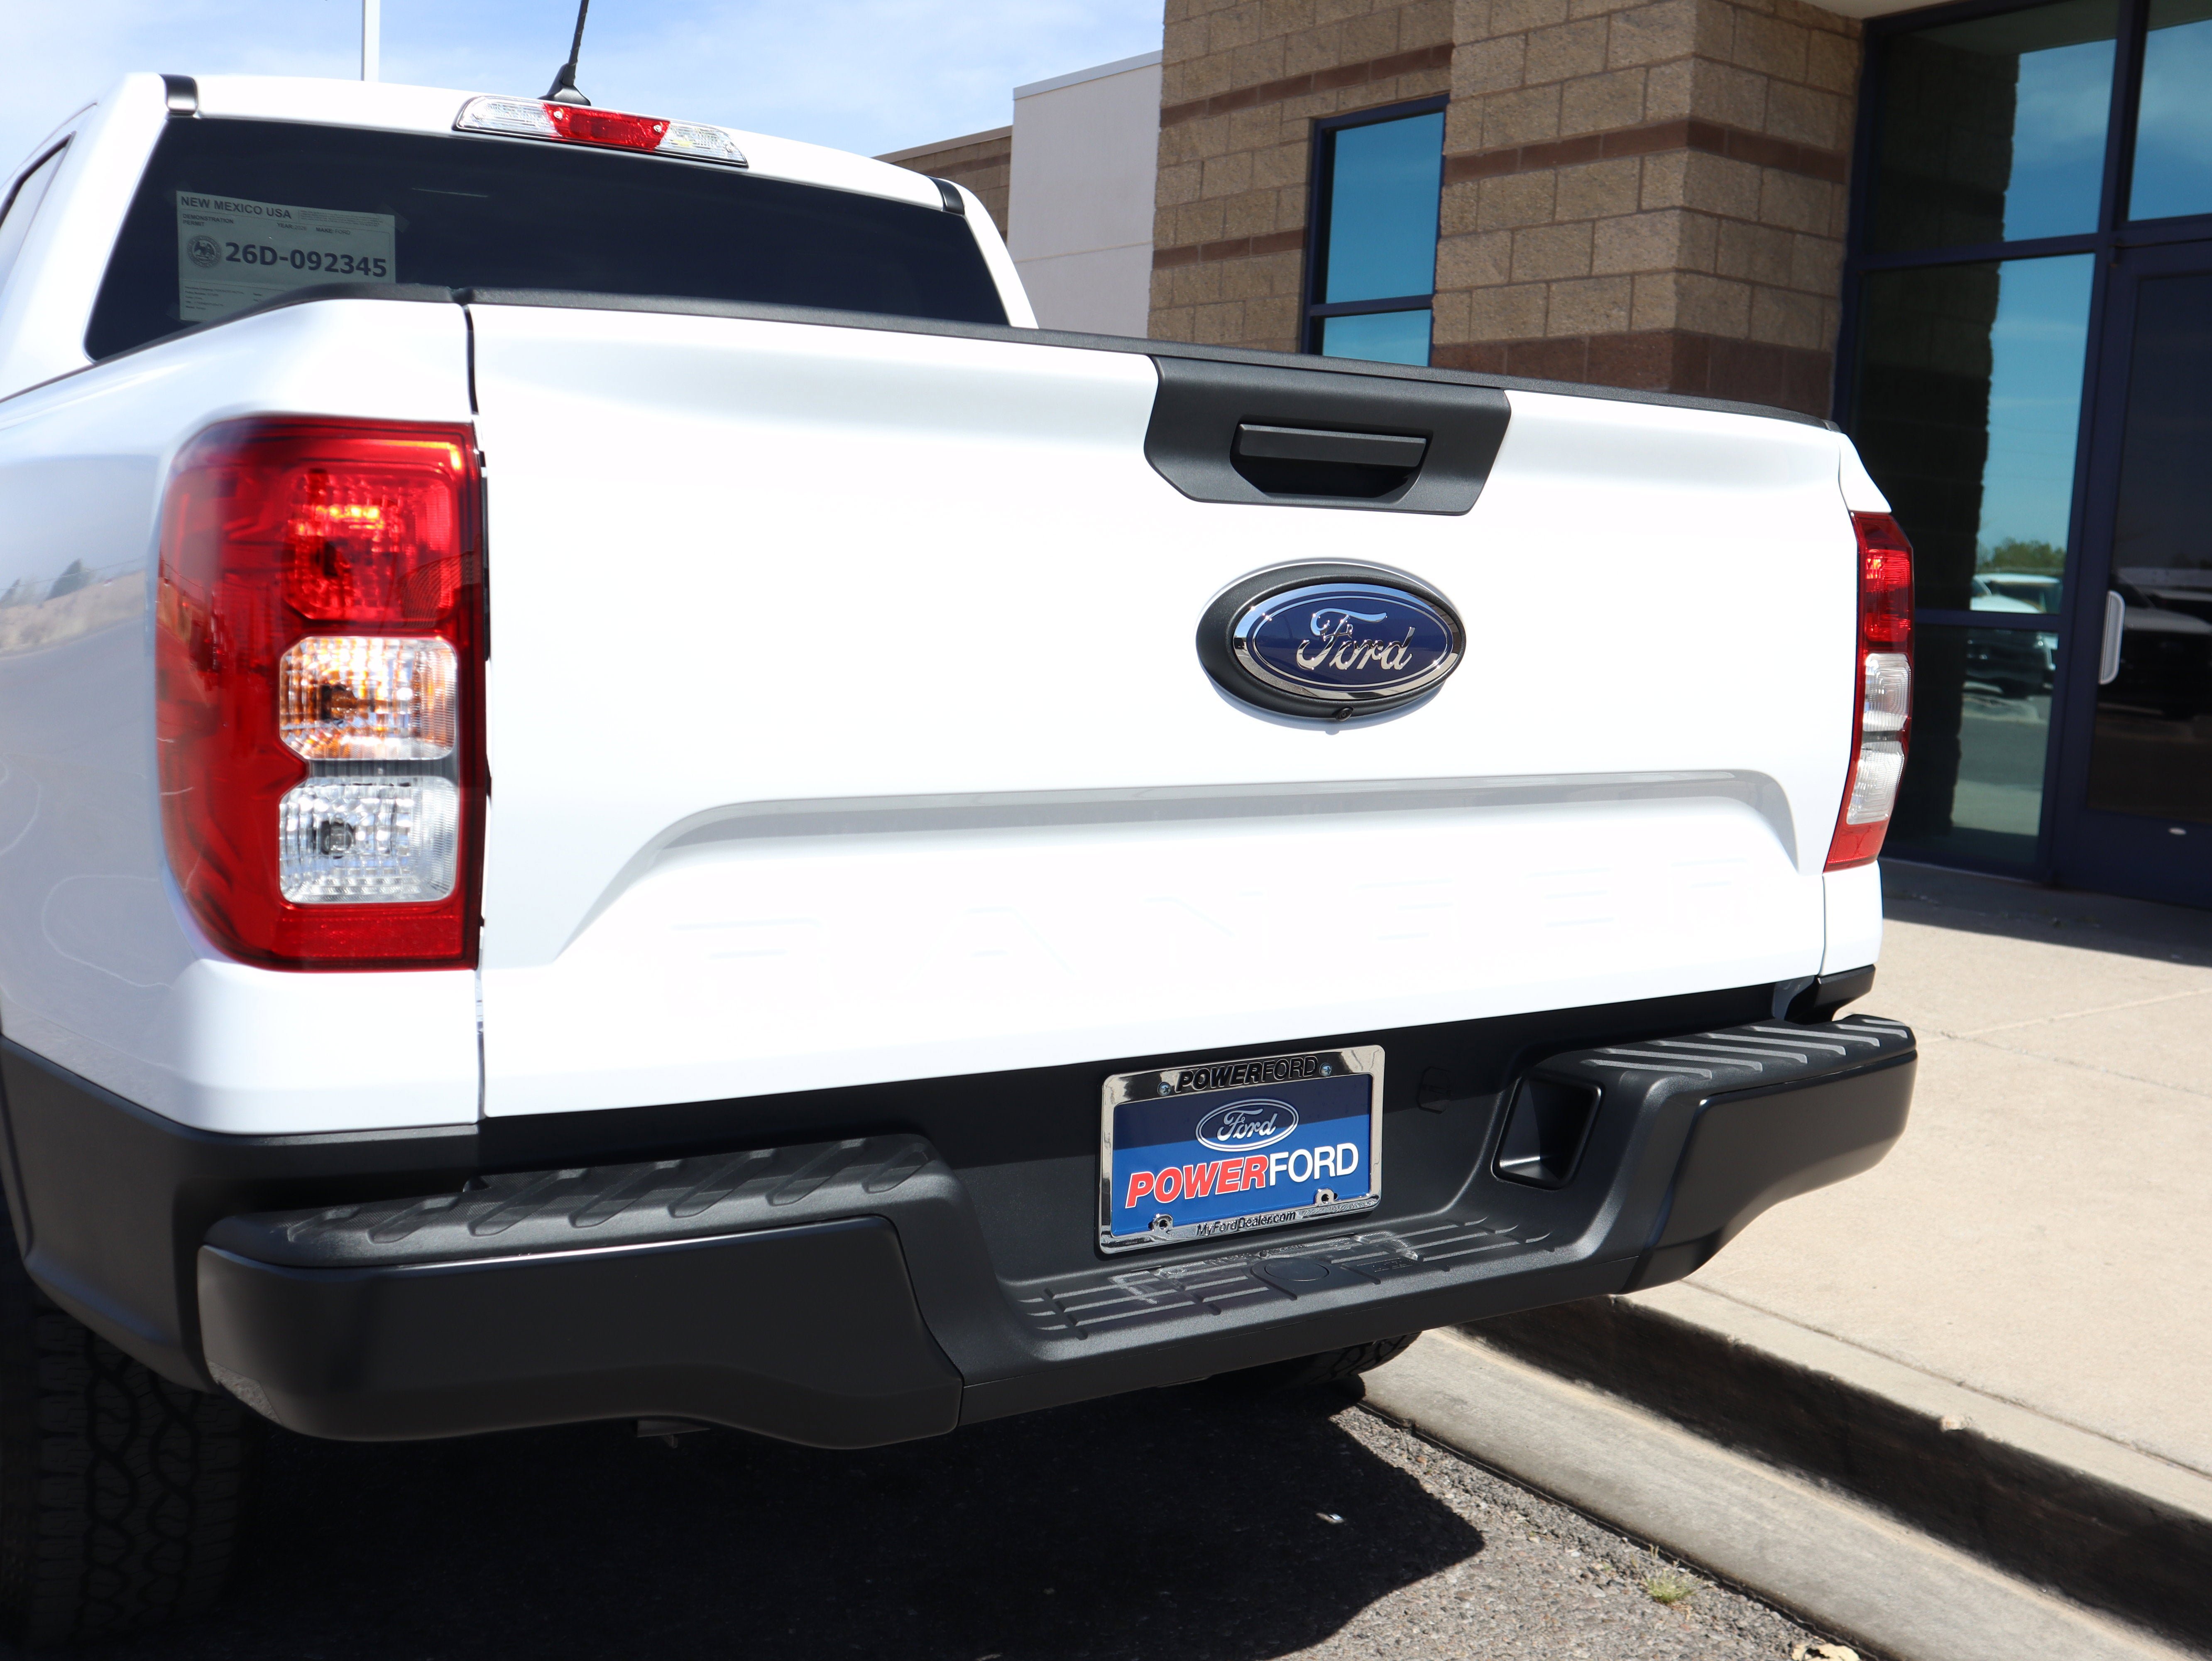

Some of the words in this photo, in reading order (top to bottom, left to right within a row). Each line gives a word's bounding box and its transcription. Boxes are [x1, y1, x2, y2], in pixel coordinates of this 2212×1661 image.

[181, 196, 210, 208] NEW
[214, 200, 262, 215] MEXICO
[267, 207, 292, 219] USA
[183, 213, 234, 224] DEMONSTRATION
[225, 242, 387, 277] 26D-092345
[1296, 608, 1416, 670] Ford
[1175, 1055, 1319, 1094] POWERFORD
[1216, 1107, 1278, 1142] Ford
[1125, 1142, 1359, 1209] POWERFORD
[1197, 1210, 1296, 1237] MyFordDealer.com
